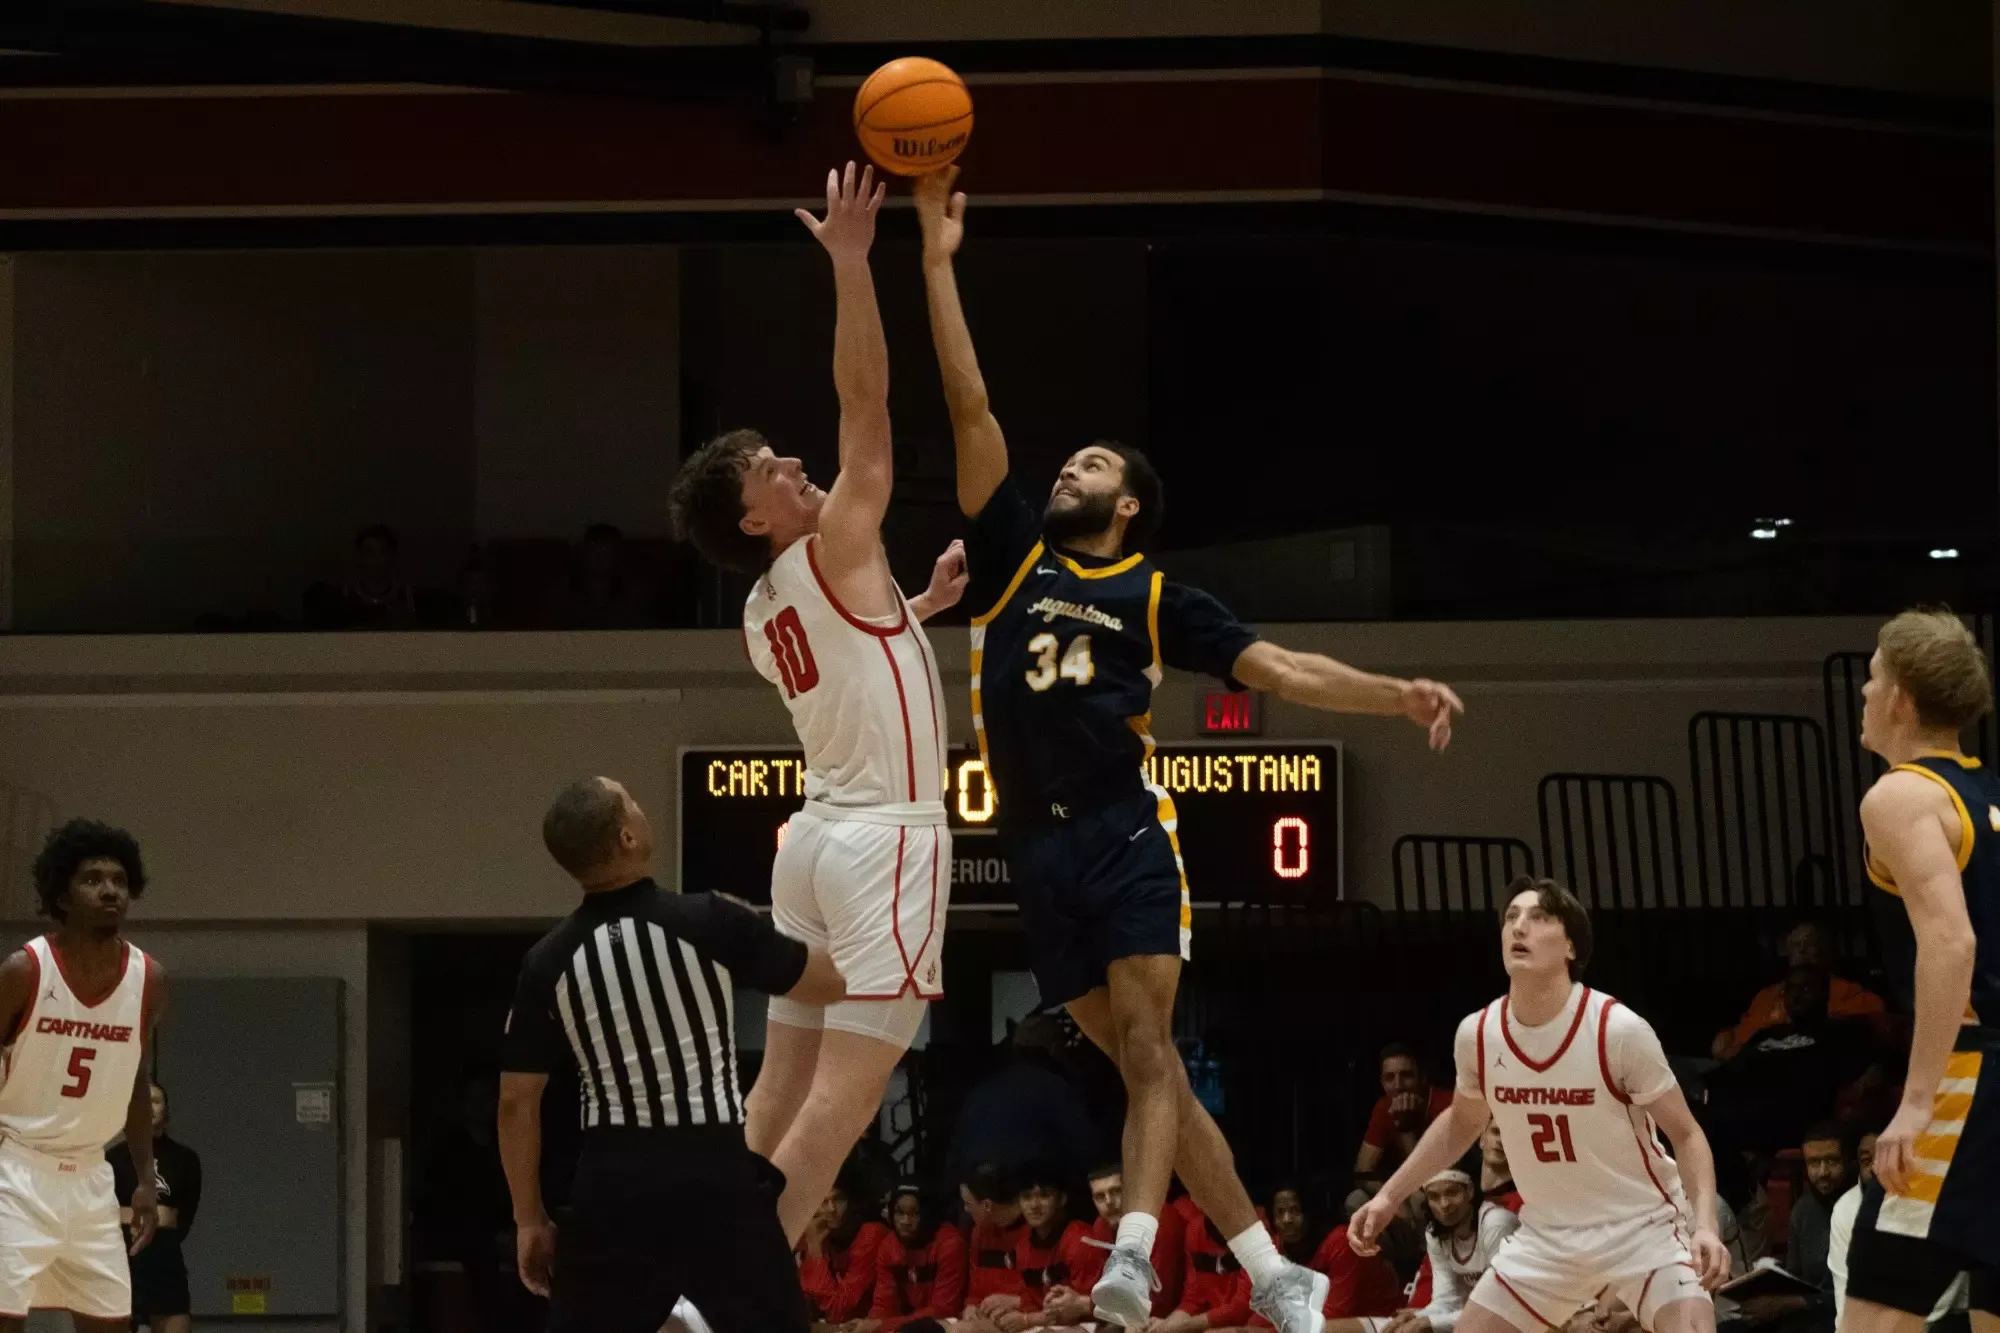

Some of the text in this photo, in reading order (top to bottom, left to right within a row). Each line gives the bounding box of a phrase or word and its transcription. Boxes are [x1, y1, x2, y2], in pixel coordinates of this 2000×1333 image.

[764, 605, 819, 699] 10
[1024, 632, 1096, 693] 34
[1204, 695, 1251, 730] EXIT
[1143, 754, 1322, 793] UGUSTANA
[1273, 816, 1310, 879] 0
[952, 858, 1012, 885] ERIO
[36, 1016, 132, 1043] CARTHAGE
[61, 1046, 97, 1099] 5
[1494, 1085, 1596, 1106] CARTHAGE
[1527, 1112, 1577, 1163] 21
